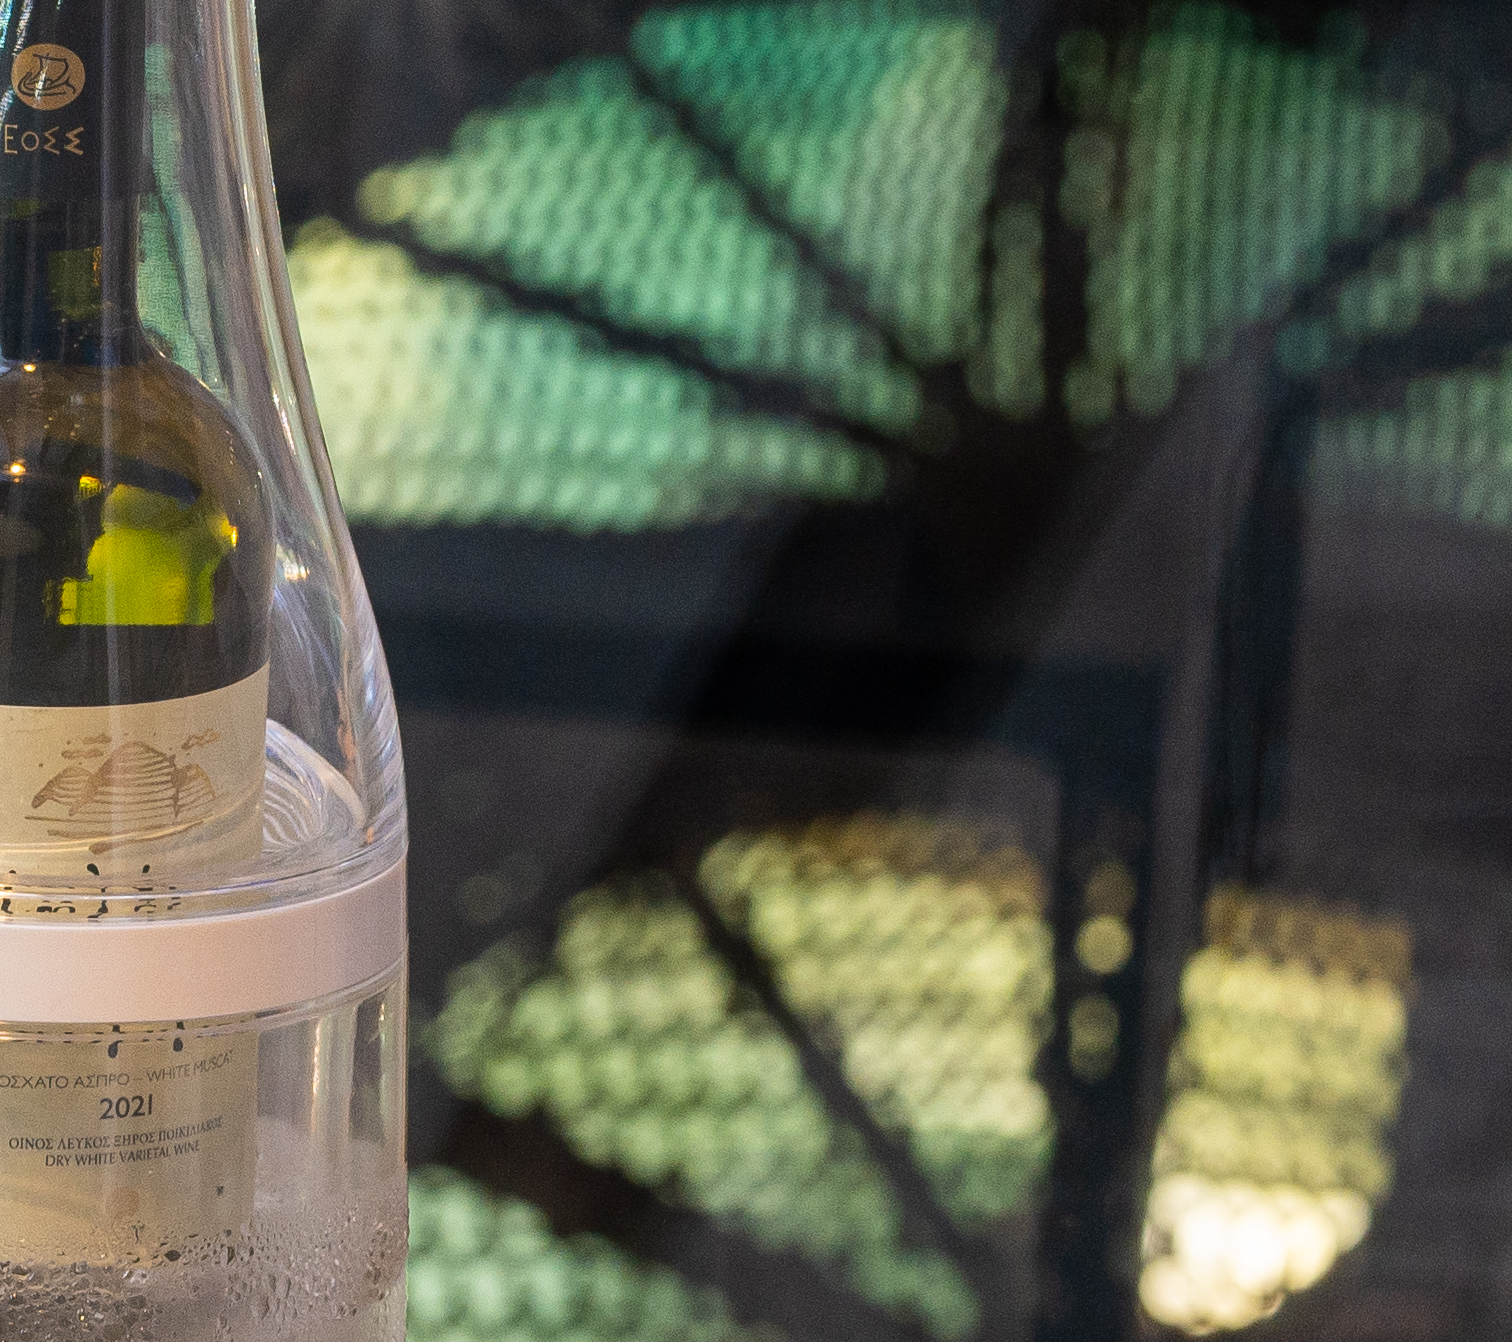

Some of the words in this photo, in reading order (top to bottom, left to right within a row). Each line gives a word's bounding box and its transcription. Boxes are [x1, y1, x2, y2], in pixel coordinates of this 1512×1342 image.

[73, 1072, 130, 1089] ΑΣΠΡΟ
[146, 1064, 190, 1082] WHITE
[99, 1094, 153, 1120] 2021
[8, 1137, 54, 1150] ΟΙΝΟΣ
[57, 1135, 111, 1150] ΛΕΥΚΟΣ
[45, 1154, 72, 1167] DRY
[75, 1152, 116, 1166] WHITE
[119, 1146, 171, 1163] VARIETAL
[173, 1140, 200, 1156] WINE
